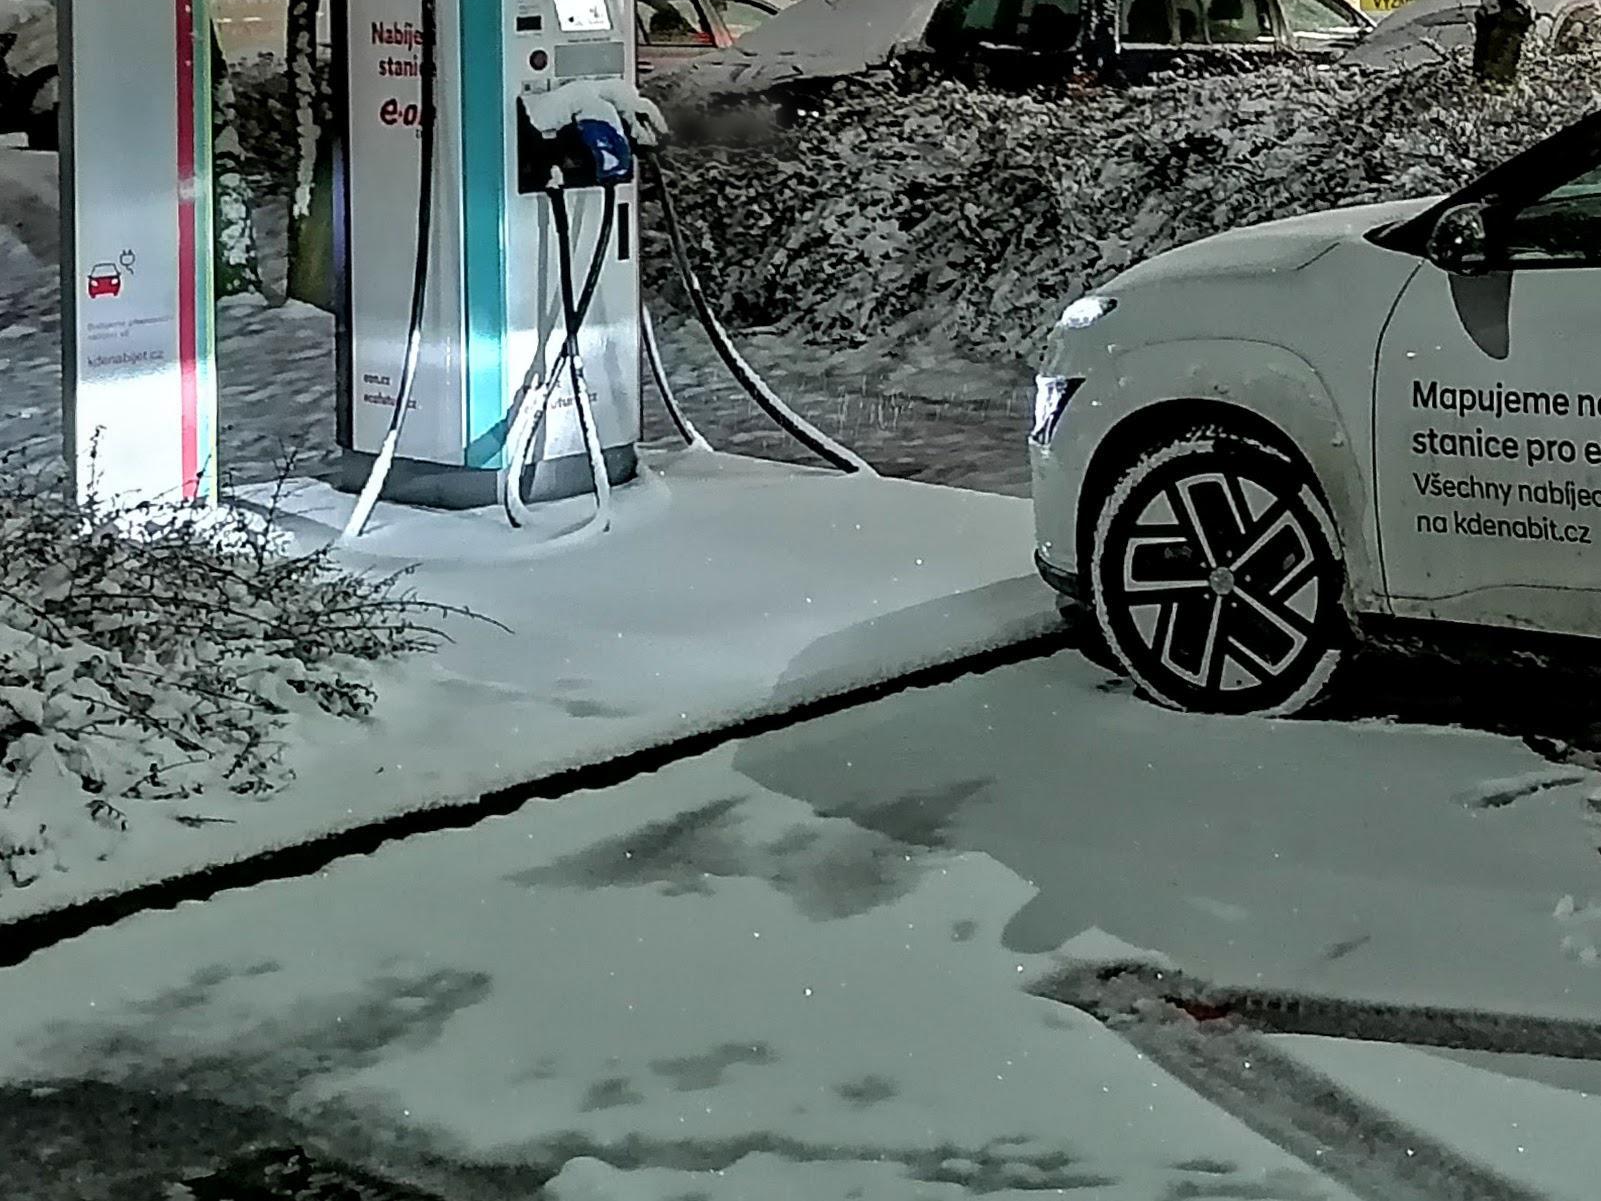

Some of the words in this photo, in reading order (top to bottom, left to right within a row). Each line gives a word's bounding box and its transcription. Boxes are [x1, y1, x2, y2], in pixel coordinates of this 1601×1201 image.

[371, 22, 424, 51] Nabíje
[378, 54, 419, 77] stani
[1412, 380, 1570, 418] Mapujeme
[1412, 427, 1519, 459] stanice
[1526, 438, 1577, 467] pro
[1412, 472, 1512, 506] Všechny
[1416, 514, 1448, 533] na
[1454, 510, 1592, 544] kdenabit.cz
